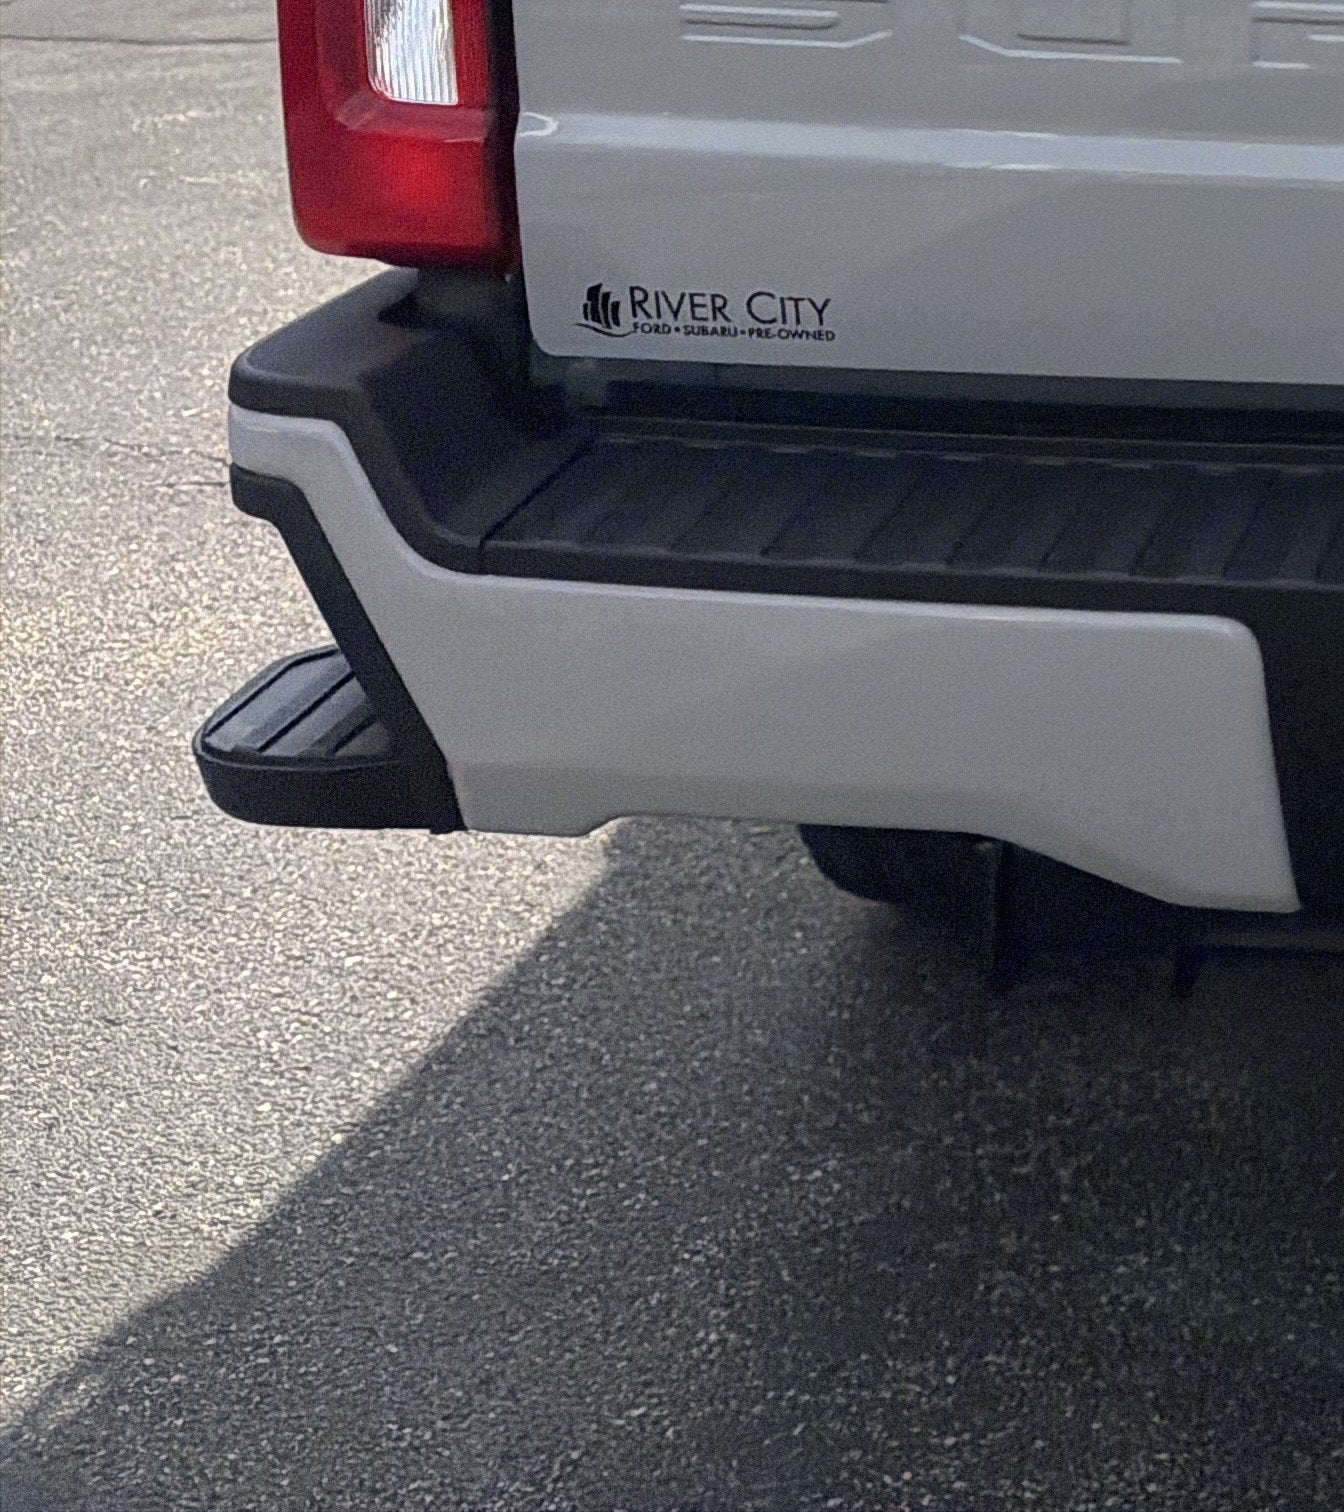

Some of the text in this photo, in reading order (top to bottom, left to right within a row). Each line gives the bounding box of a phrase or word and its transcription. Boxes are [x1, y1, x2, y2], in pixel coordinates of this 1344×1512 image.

[632, 321, 836, 341] FORD SUBARU PRE-OWNED
